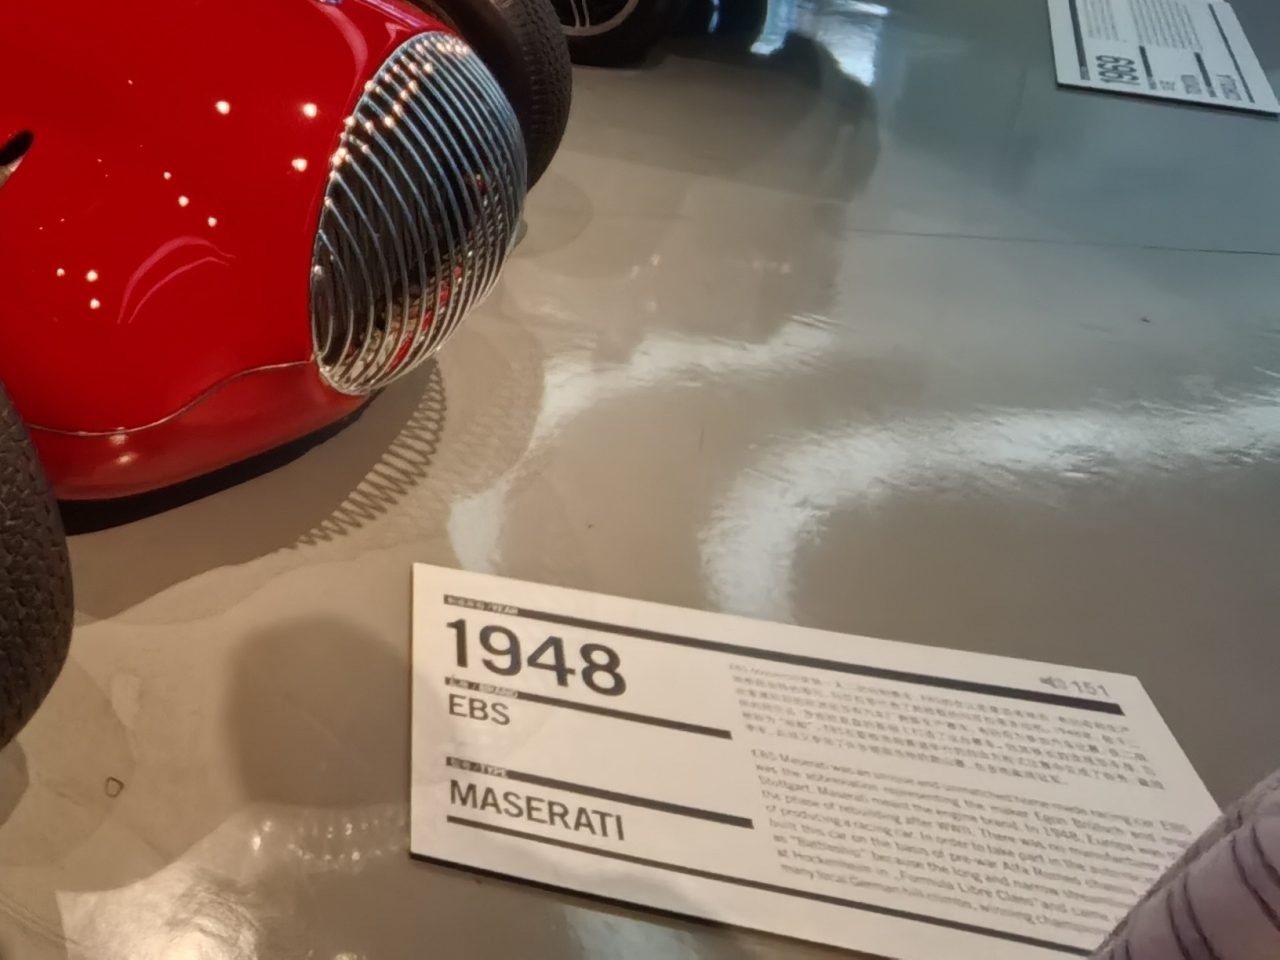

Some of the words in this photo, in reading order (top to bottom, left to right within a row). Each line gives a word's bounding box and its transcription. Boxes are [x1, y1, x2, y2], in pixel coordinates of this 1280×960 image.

[1096, 55, 1140, 85] 1969
[446, 618, 626, 696] 1948
[1072, 679, 1110, 697] 151
[449, 693, 510, 726] EBS
[450, 779, 624, 841] MASERATI
